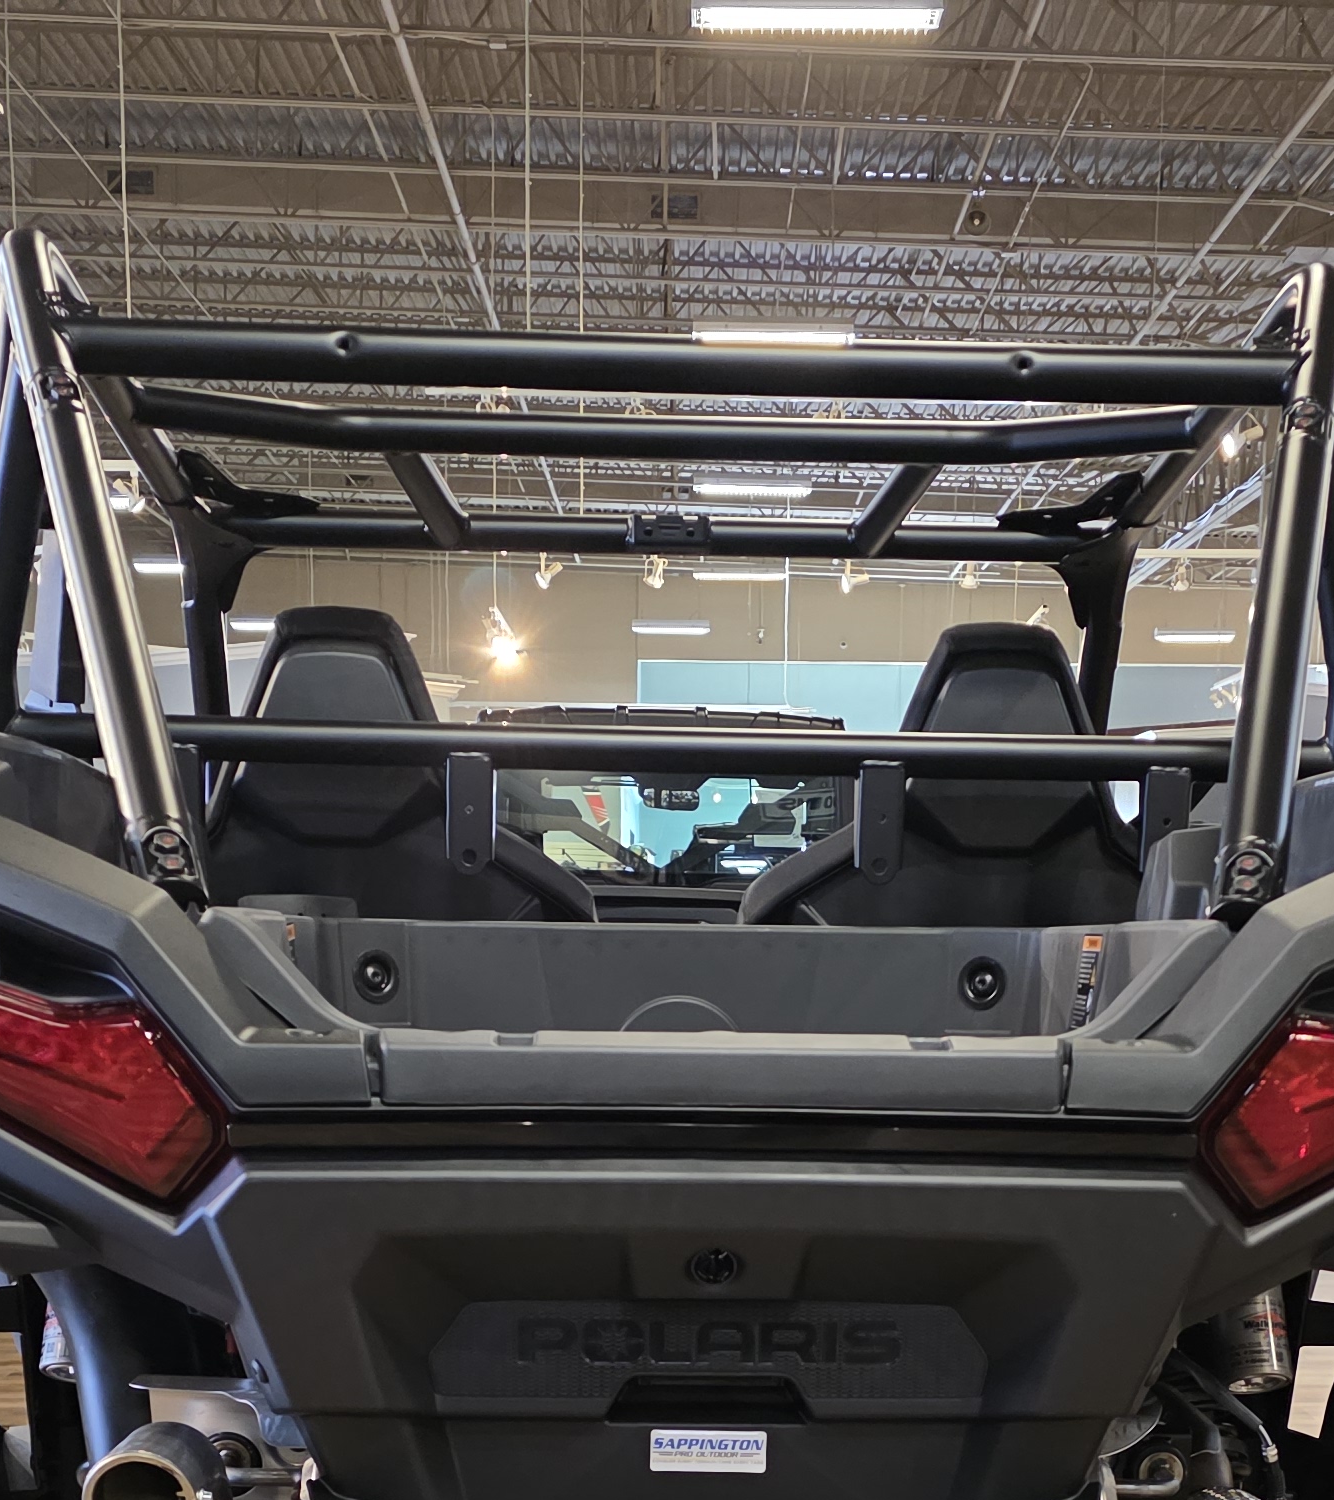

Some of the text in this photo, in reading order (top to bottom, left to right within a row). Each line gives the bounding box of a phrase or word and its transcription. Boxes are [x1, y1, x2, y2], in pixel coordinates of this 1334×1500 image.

[517, 1317, 902, 1366] POLARIS
[652, 1437, 764, 1451] SAPPINGTON
[673, 1450, 739, 1458] PRO OUTDOOR
